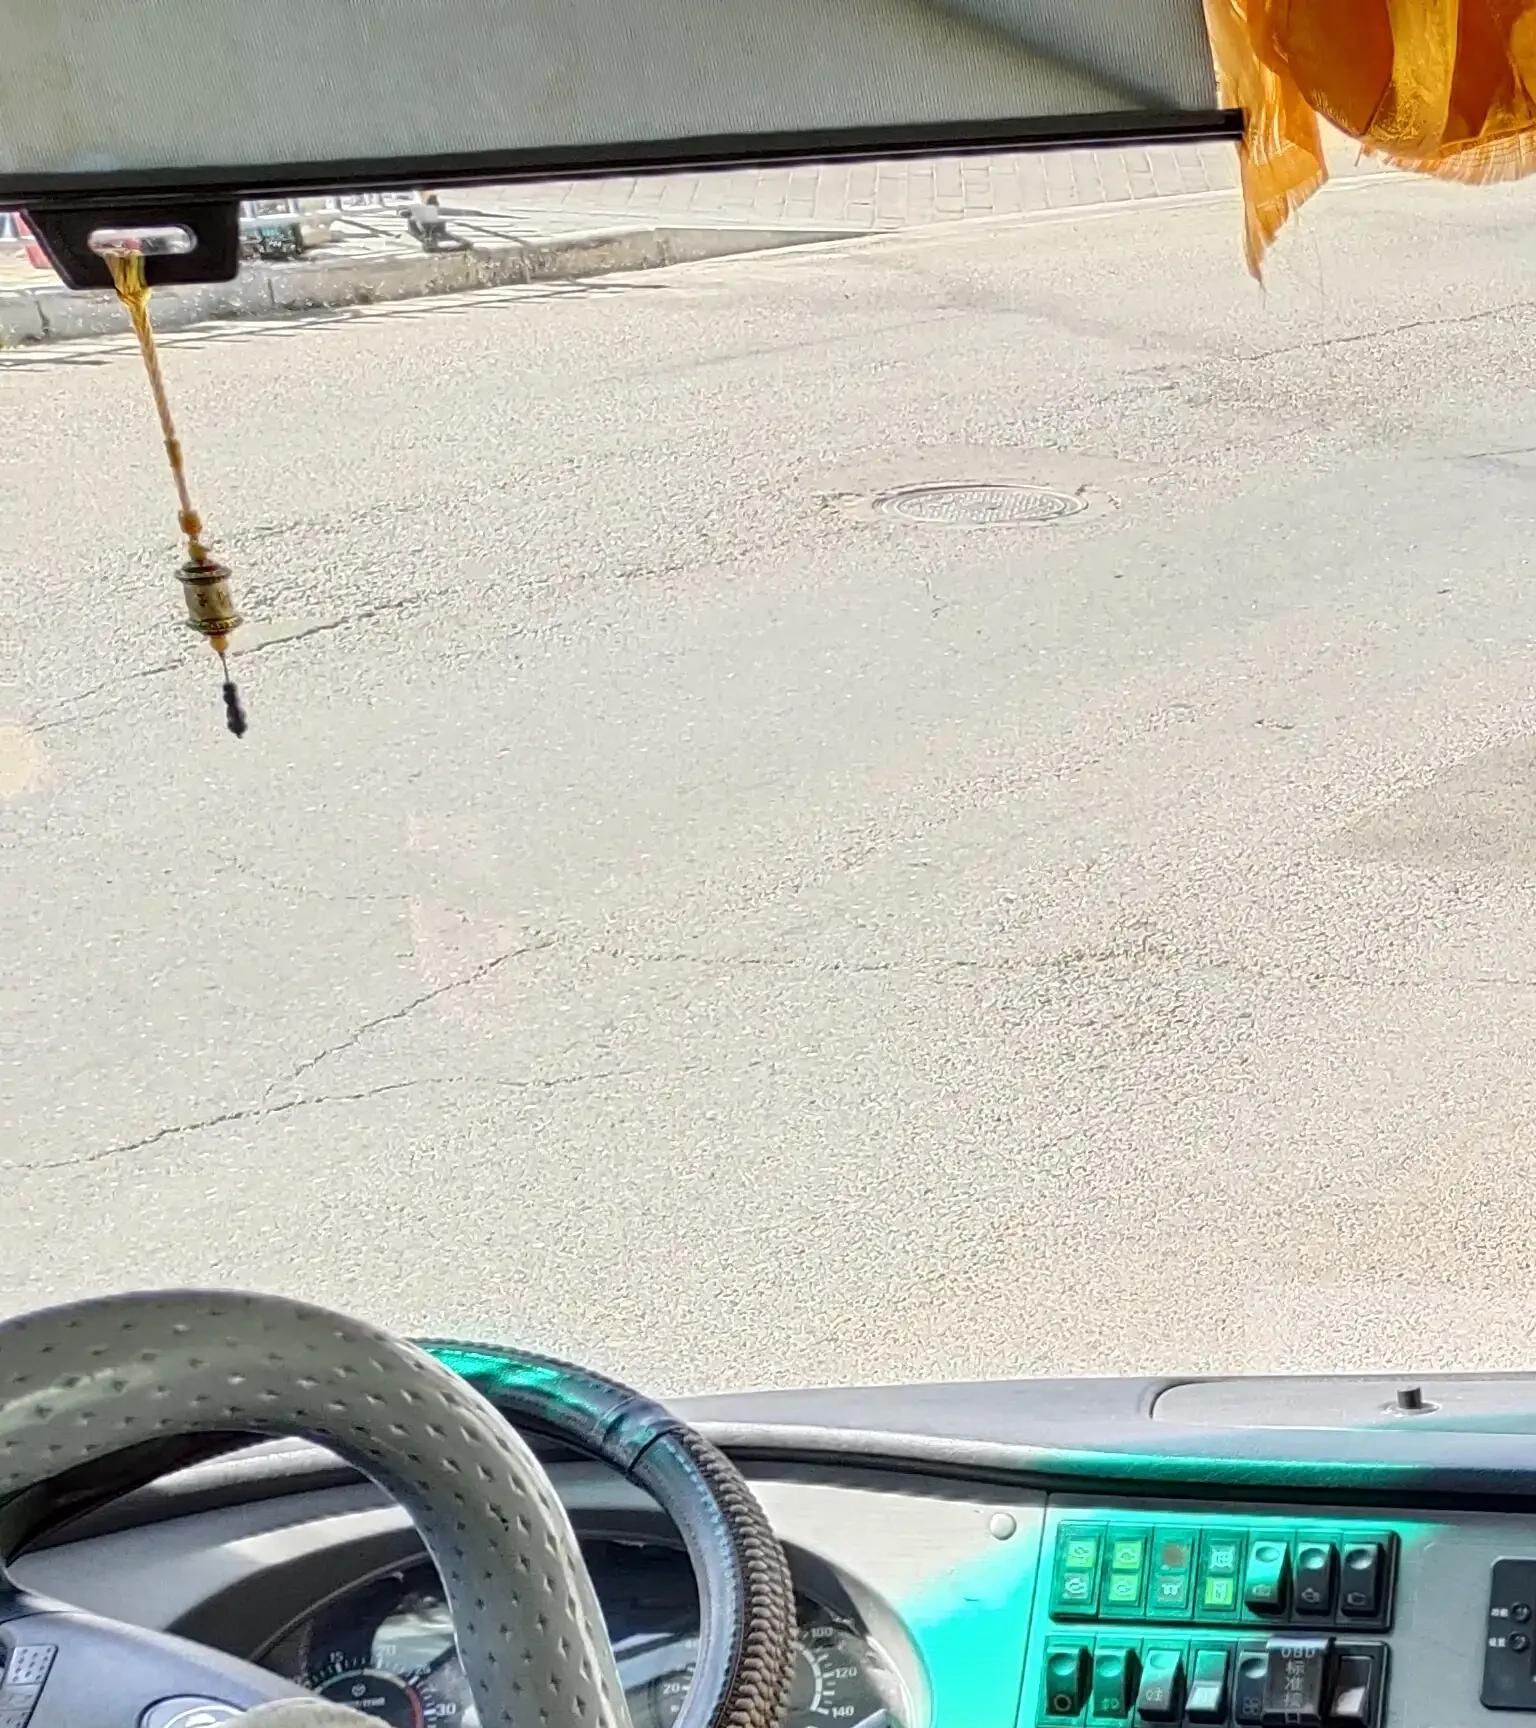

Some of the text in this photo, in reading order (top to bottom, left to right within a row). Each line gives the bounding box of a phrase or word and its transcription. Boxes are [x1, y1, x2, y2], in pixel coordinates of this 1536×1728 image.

[811, 1627, 833, 1637] 100
[836, 1667, 857, 1678] 120
[663, 1683, 680, 1694] 20
[436, 1703, 456, 1716] 30
[832, 1706, 854, 1718] 140
